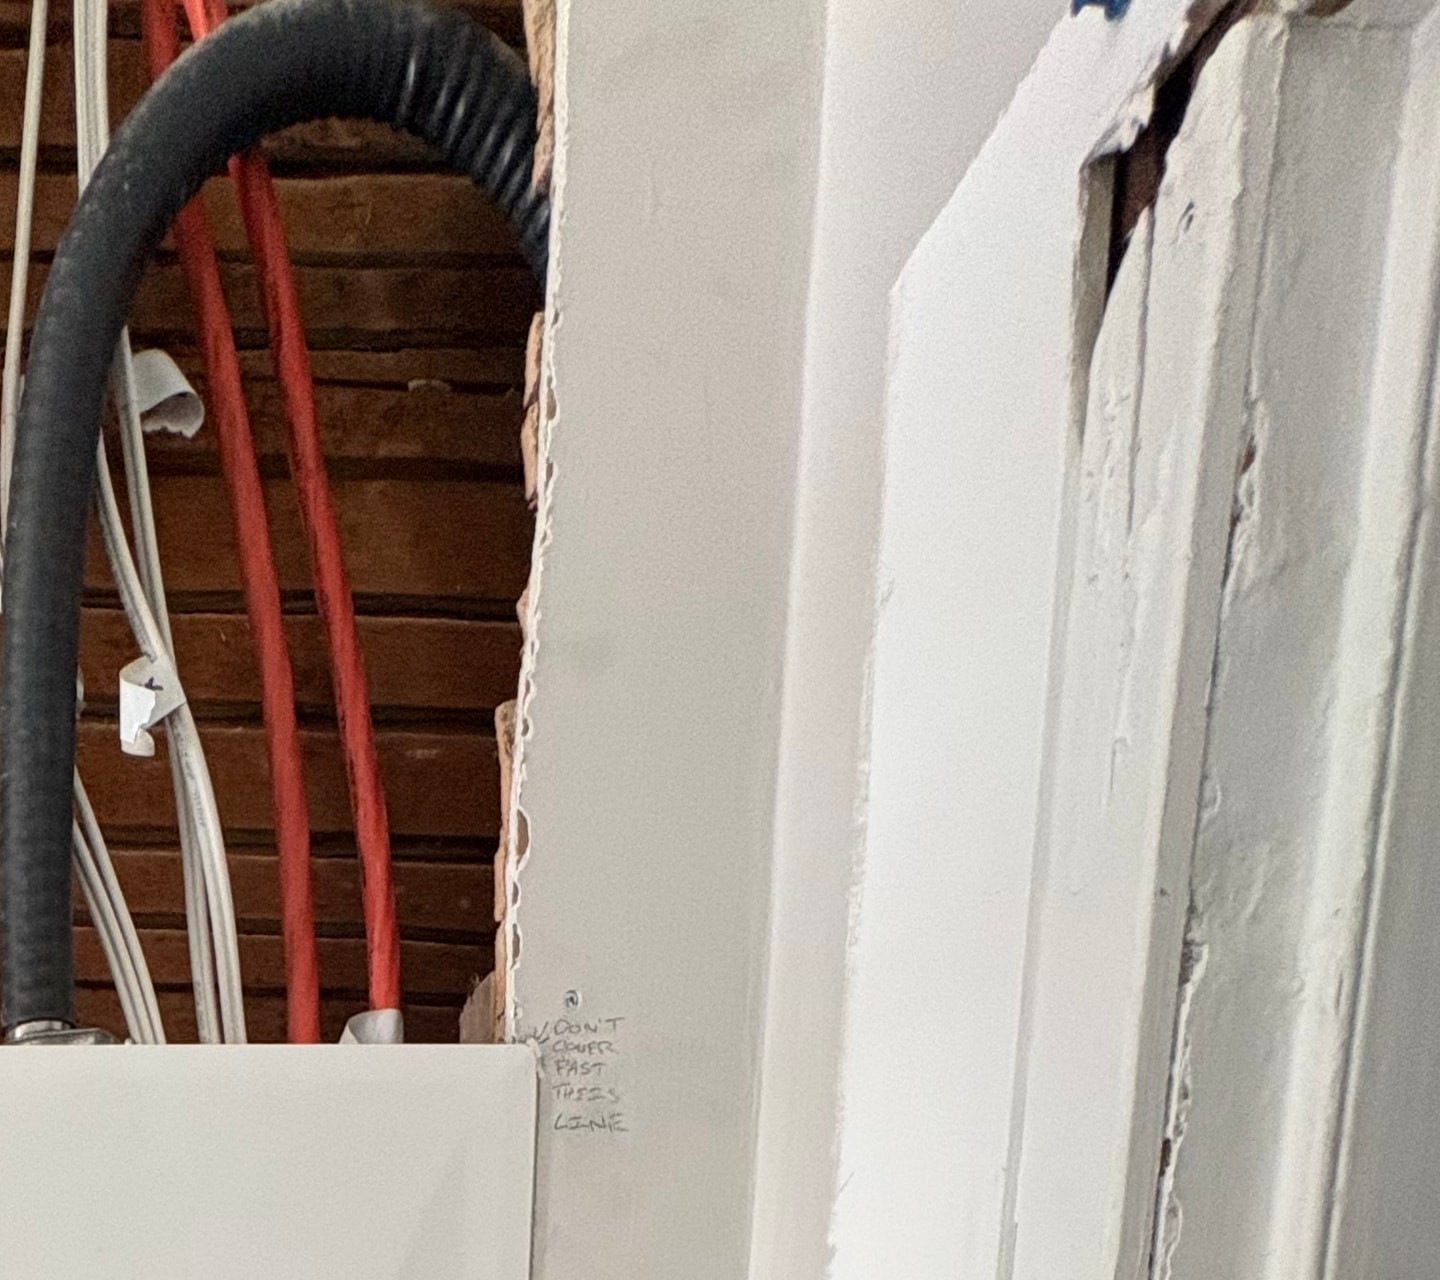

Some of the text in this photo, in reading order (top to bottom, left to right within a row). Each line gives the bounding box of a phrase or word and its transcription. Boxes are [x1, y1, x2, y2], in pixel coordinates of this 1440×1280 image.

[553, 1017, 626, 1036] DON'T
[554, 1057, 607, 1077] PAST
[554, 1113, 629, 1133] LINE
